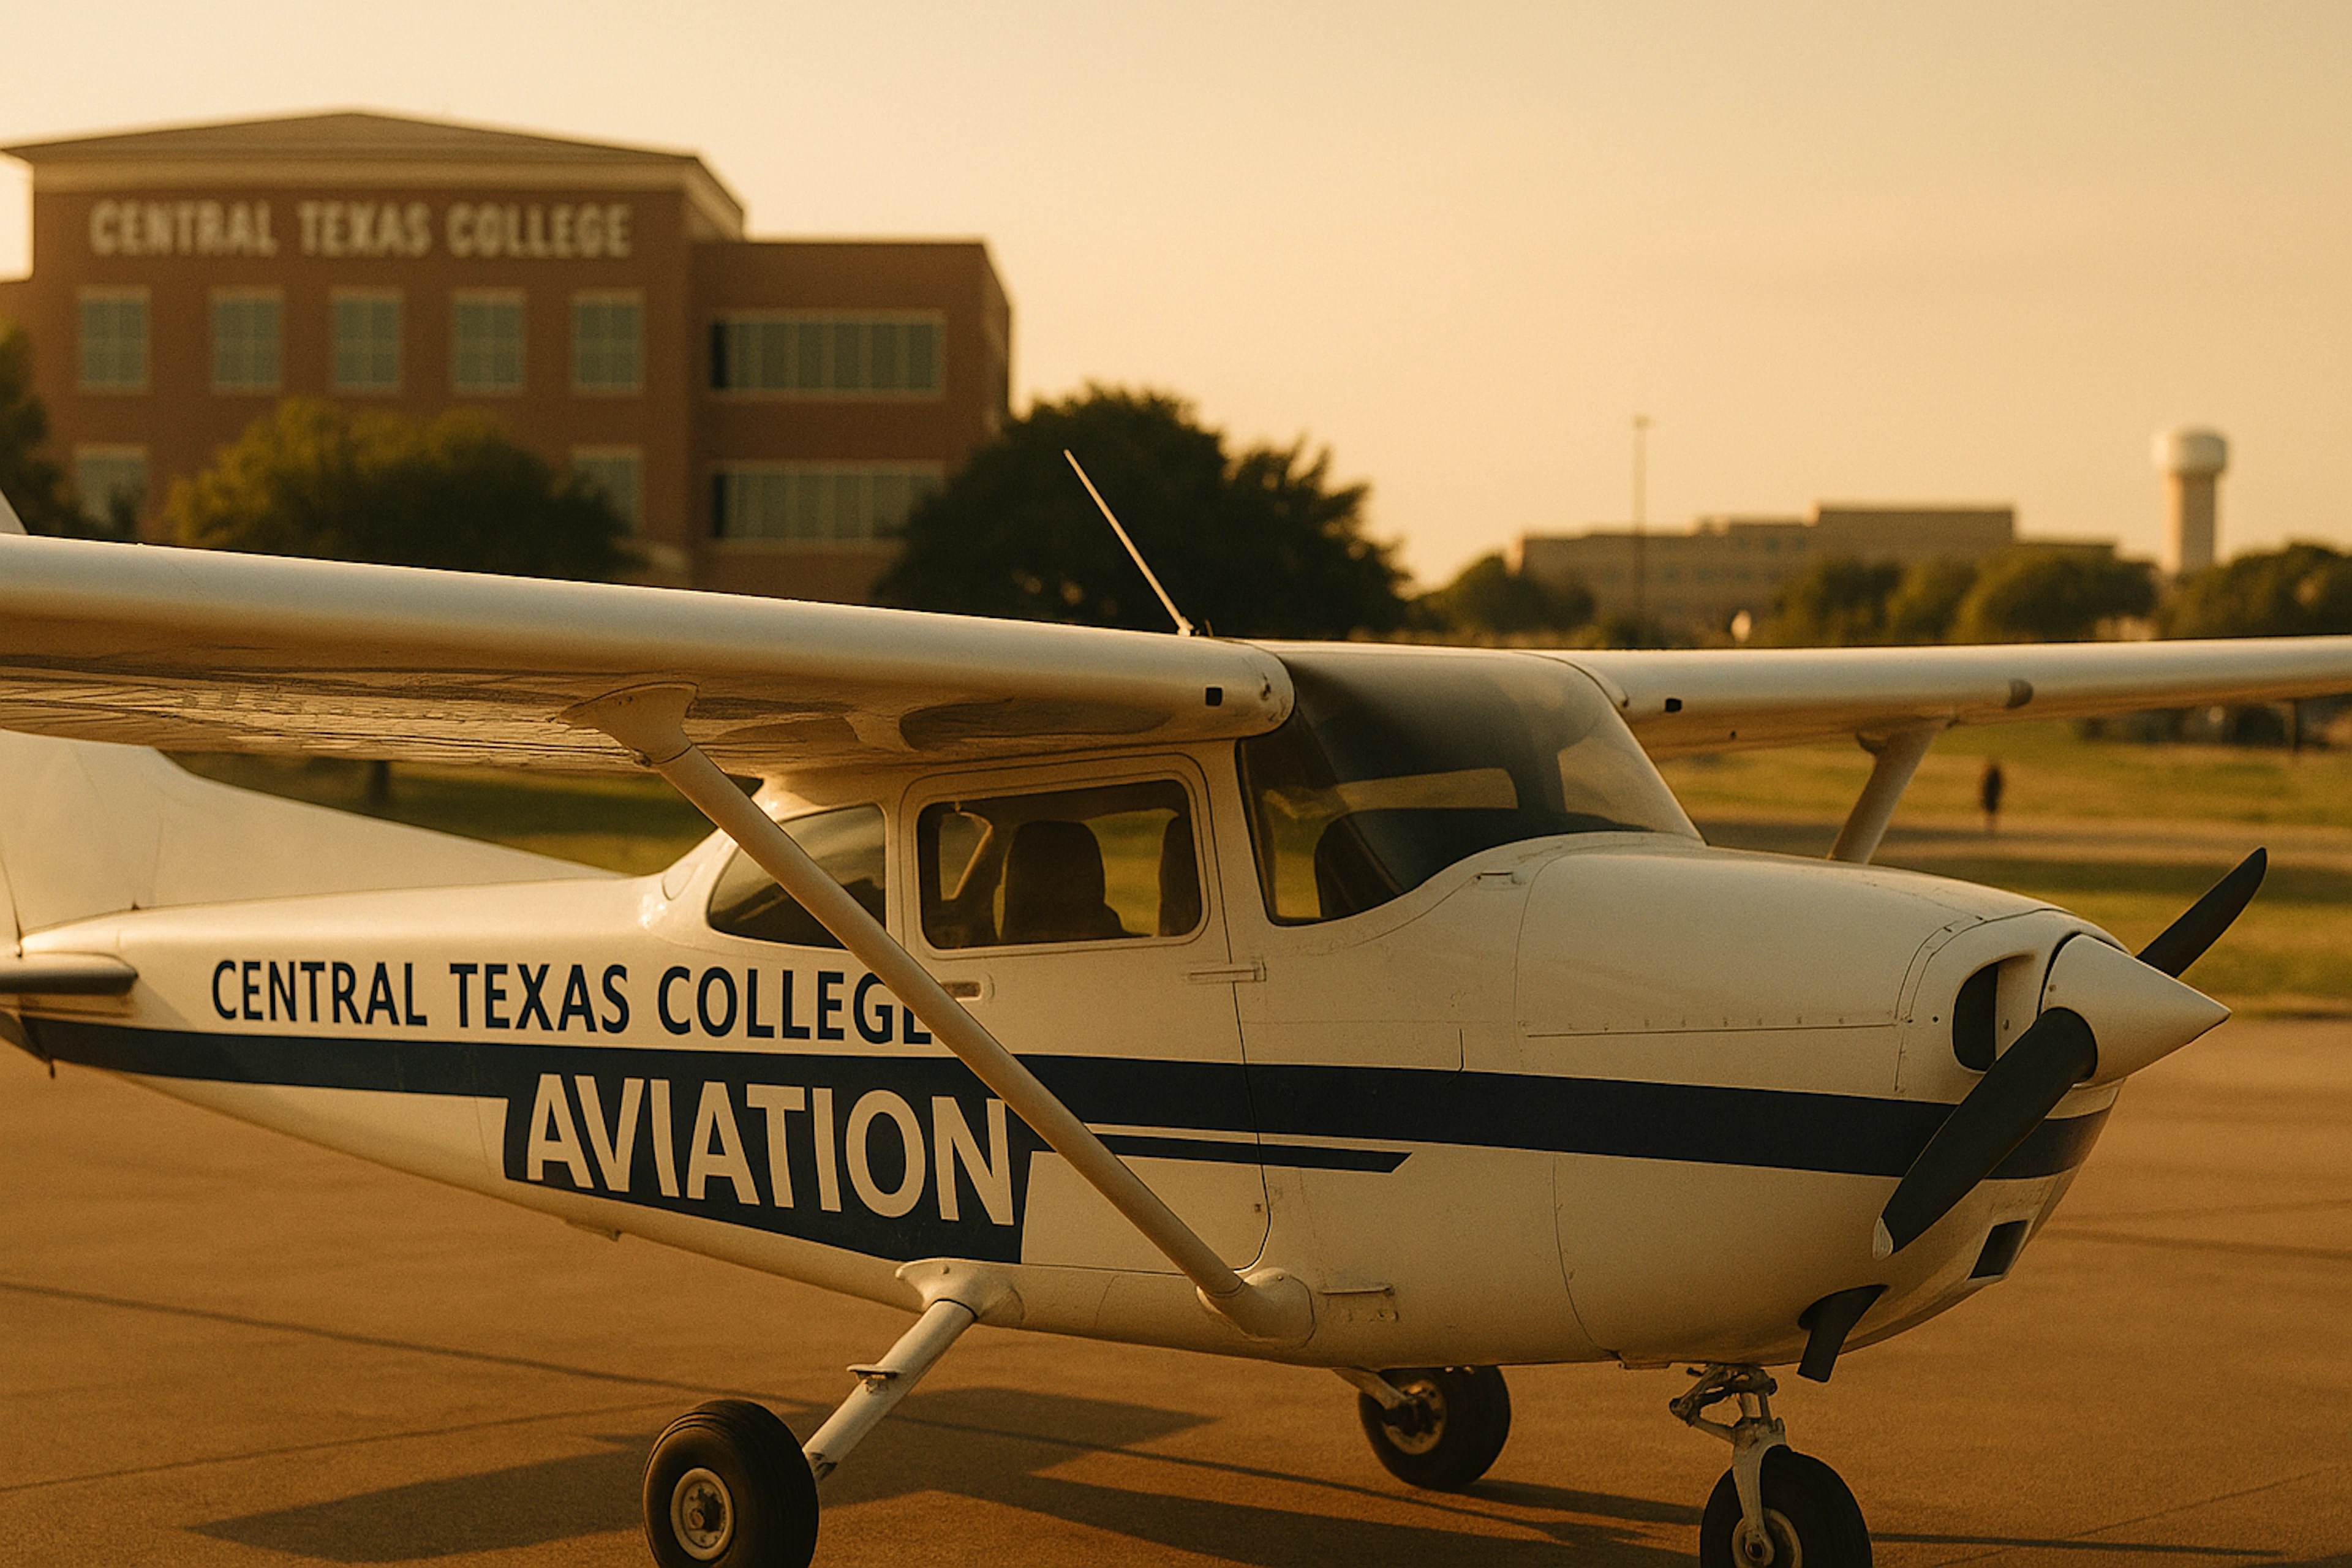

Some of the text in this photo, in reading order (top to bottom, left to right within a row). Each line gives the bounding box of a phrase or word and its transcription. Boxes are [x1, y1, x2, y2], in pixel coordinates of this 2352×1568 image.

[90, 201, 633, 258] CENTRAL TEXAS COLLEGE
[212, 960, 428, 1026] CENTRAL
[449, 963, 630, 1034] TEXAS
[527, 1073, 1015, 1226] AVIATION
